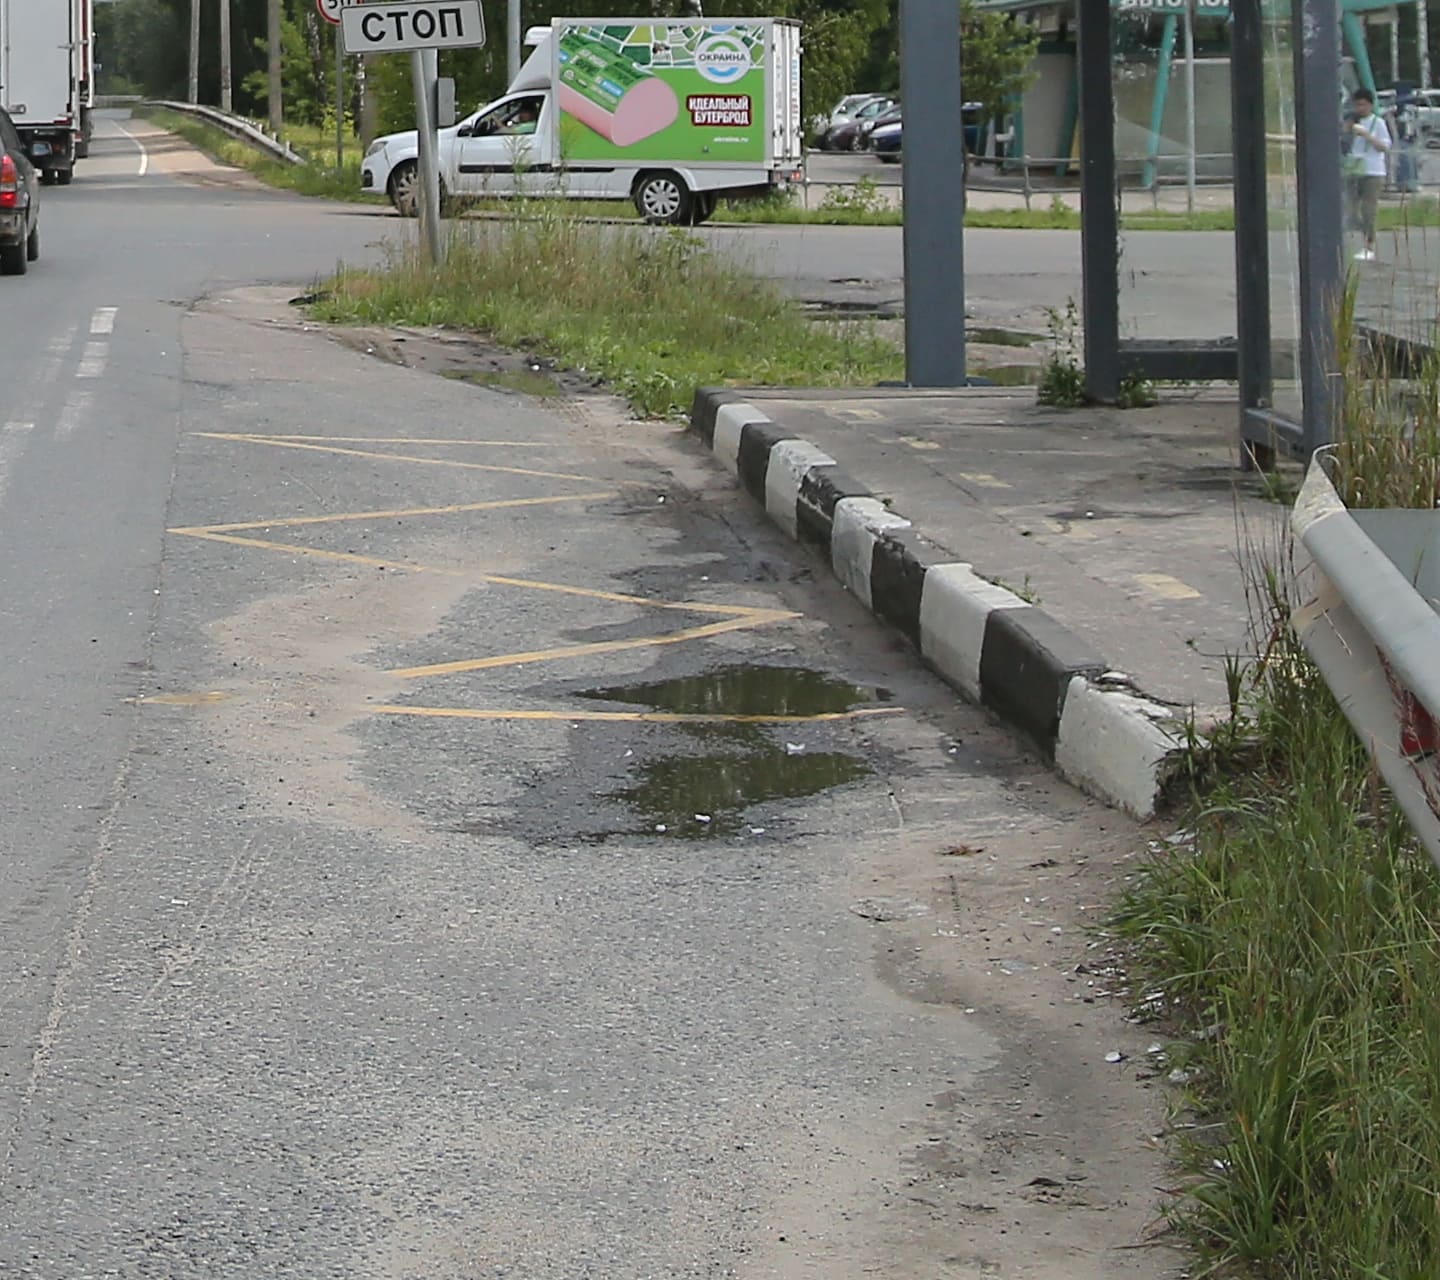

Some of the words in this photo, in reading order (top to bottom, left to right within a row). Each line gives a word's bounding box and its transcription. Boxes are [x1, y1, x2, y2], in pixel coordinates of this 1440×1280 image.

[361, 8, 464, 42] СТОП
[699, 53, 747, 62] ОКРАИНА
[688, 96, 749, 111] ИДЕАЛЬНЫЙ
[694, 110, 750, 124] БУТЕРБРОД
